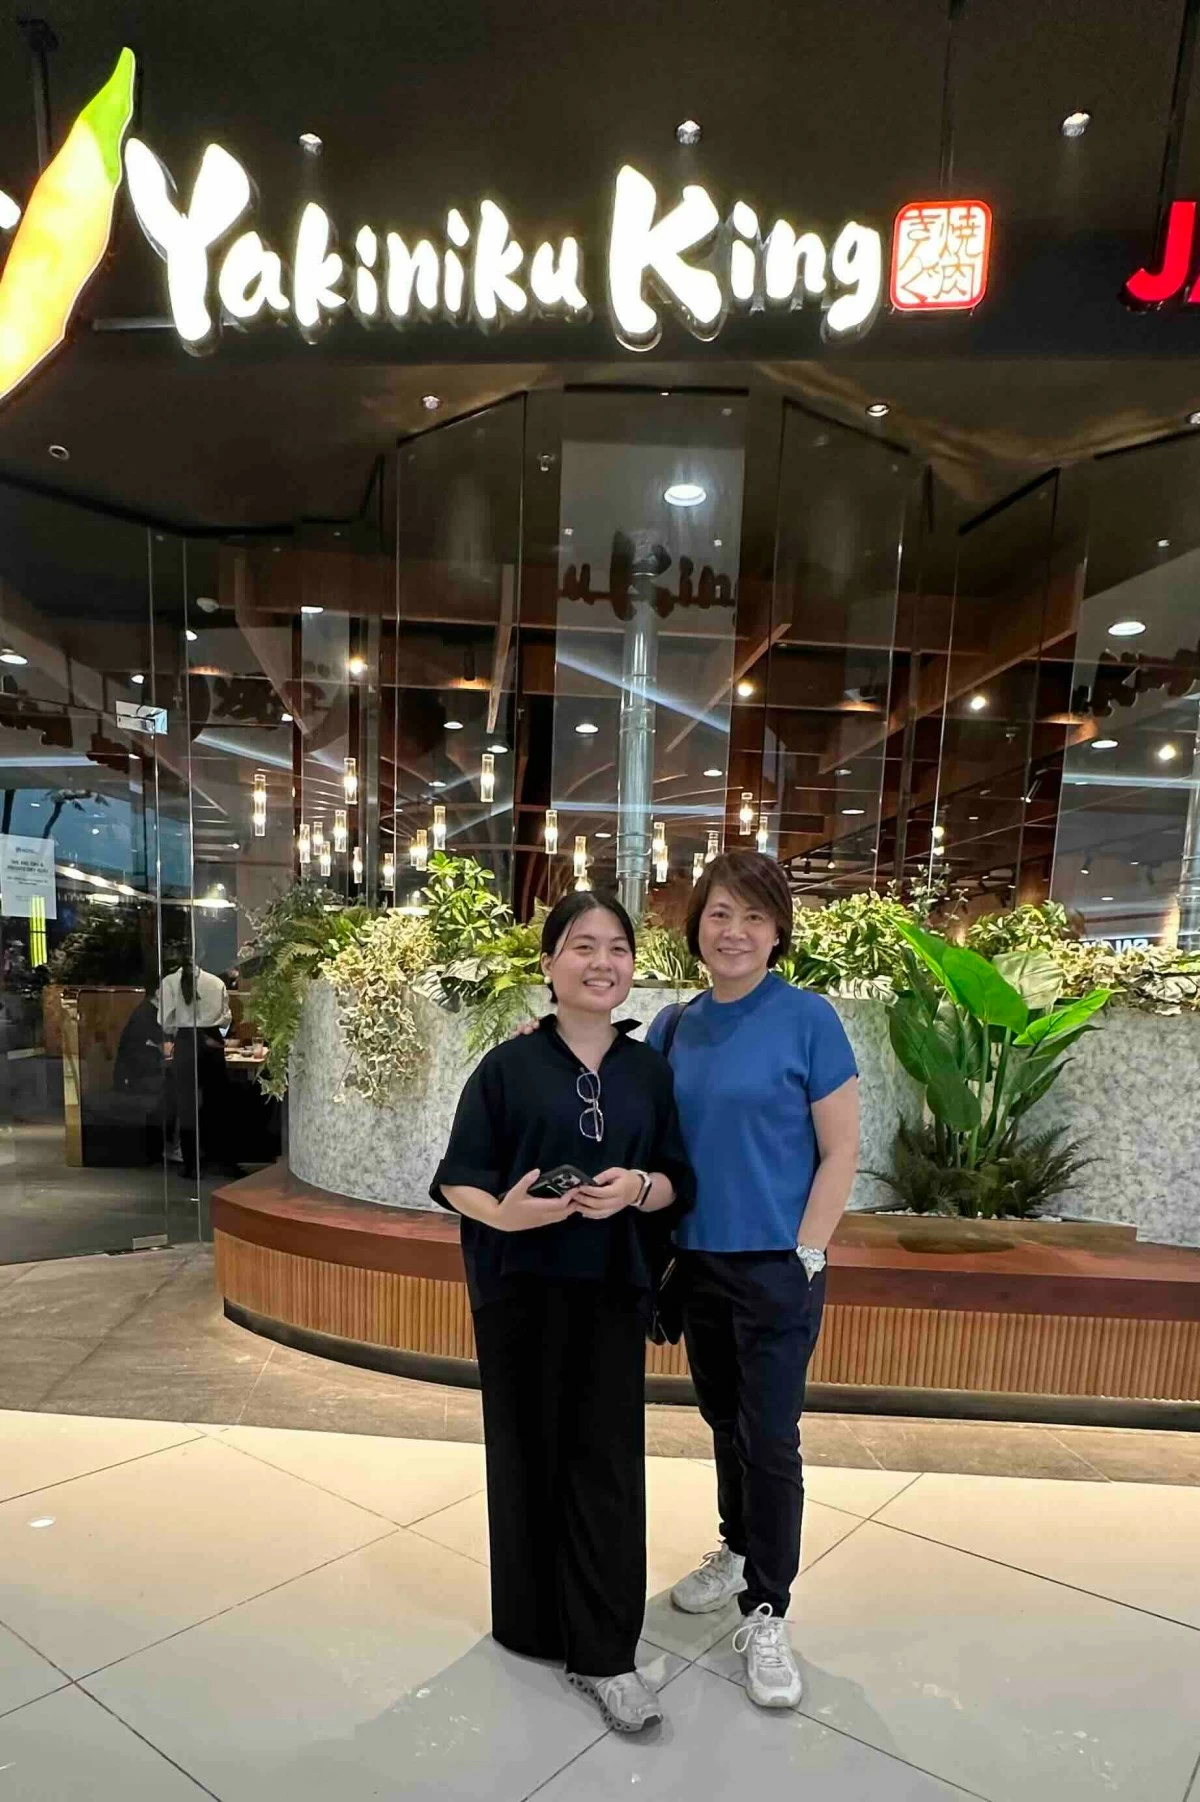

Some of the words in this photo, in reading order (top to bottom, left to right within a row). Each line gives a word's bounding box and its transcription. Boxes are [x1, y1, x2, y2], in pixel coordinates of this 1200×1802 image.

[124, 137, 588, 342] Yakiniku
[608, 164, 882, 335] King
[1126, 201, 1200, 303] J
